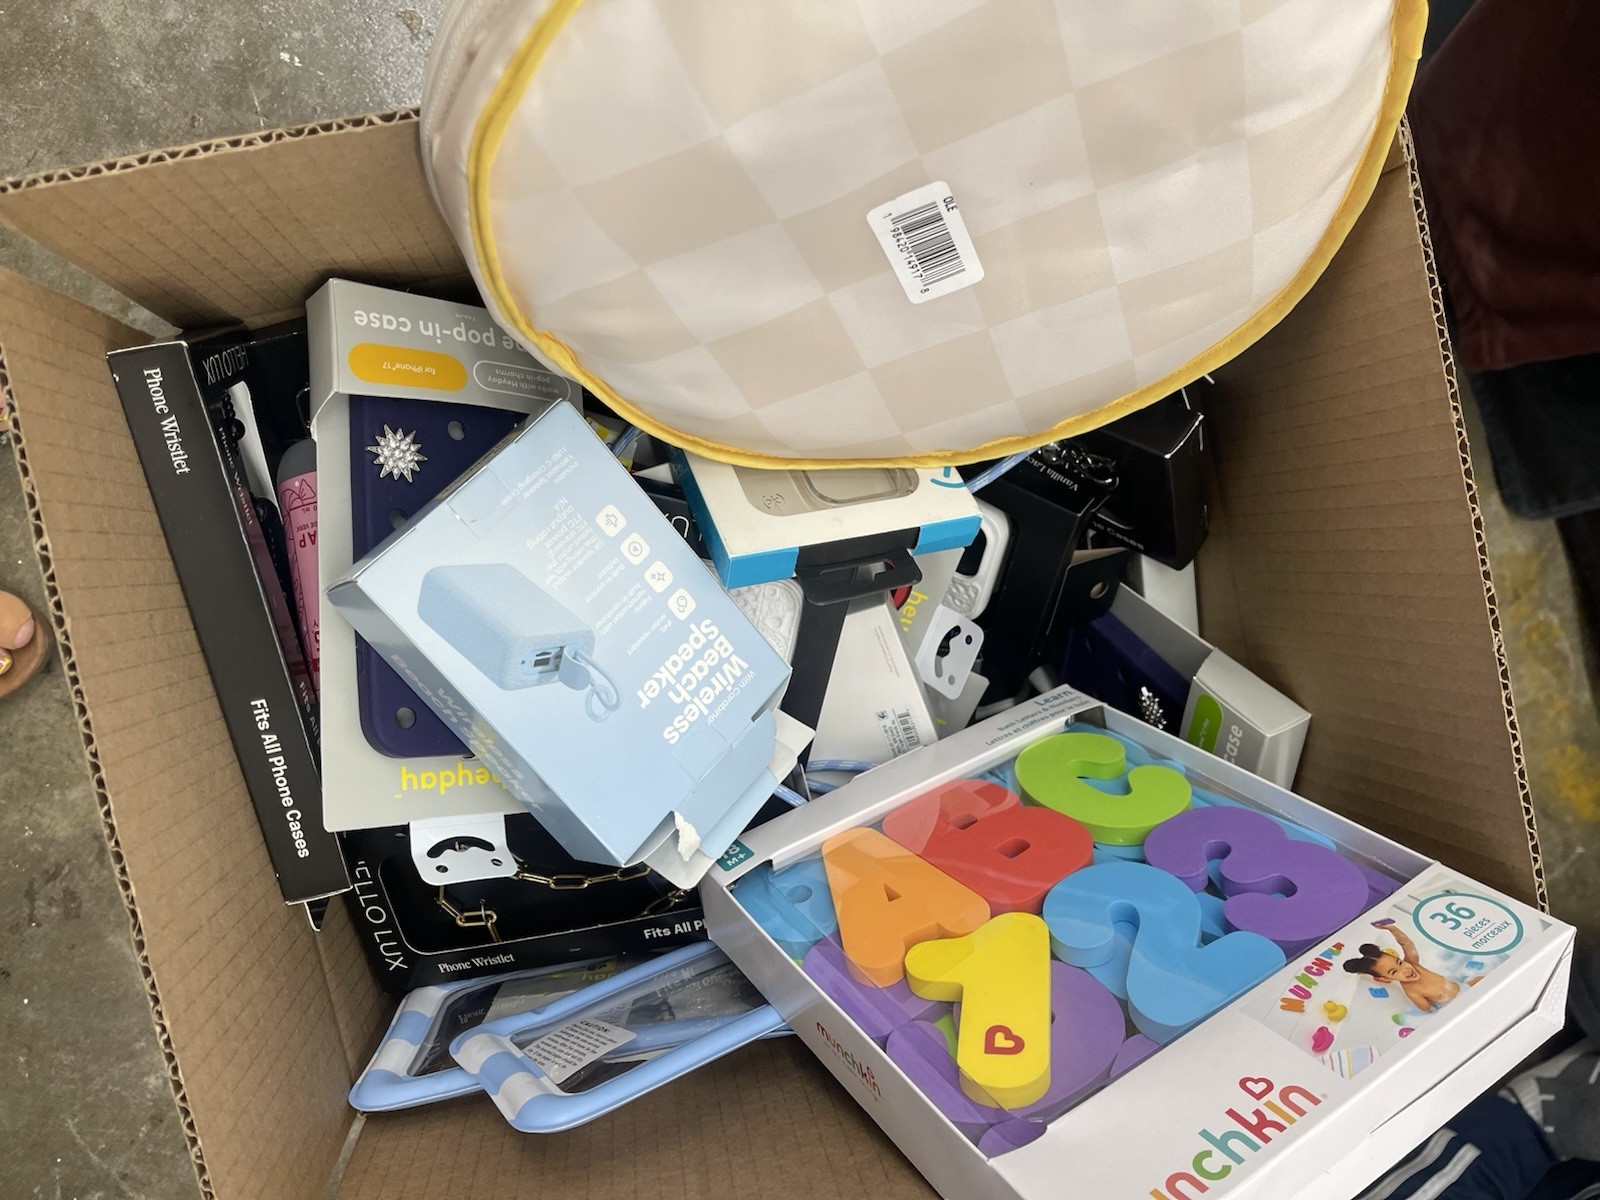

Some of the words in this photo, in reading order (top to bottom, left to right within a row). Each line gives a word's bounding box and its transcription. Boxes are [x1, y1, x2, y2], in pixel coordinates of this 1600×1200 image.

[354, 309, 412, 332] case
[419, 319, 496, 347] pop-in
[202, 354, 225, 386] LUX
[382, 361, 392, 370] 17
[424, 366, 436, 376] for
[495, 369, 524, 379] charms
[526, 374, 550, 383] pop-in
[488, 375, 518, 388] Heyday
[520, 382, 536, 391] with
[143, 368, 169, 414] Phone
[160, 414, 191, 476] Wristlet
[1046, 468, 1078, 491] Vanilla
[550, 505, 574, 529] output
[553, 497, 568, 511] N/A
[567, 512, 583, 528] FTC
[545, 524, 568, 549] power
[636, 619, 719, 709] Speaker
[667, 631, 735, 704] Beach
[738, 670, 756, 688] With
[663, 655, 749, 744] Wireless
[707, 687, 741, 726] Carabiner
[1016, 711, 1042, 723] Letters
[1048, 696, 1082, 709] Numbers
[1034, 690, 1072, 706] Learn
[250, 698, 270, 731] Fits
[986, 732, 1013, 746] Lettres
[1022, 716, 1049, 729] chiffres
[1050, 708, 1066, 717] pour
[261, 734, 282, 754] All
[390, 654, 458, 723] Beach
[460, 726, 544, 812] Speaker
[438, 688, 524, 780] Wireless
[268, 756, 294, 808] Phone
[286, 810, 310, 858] Cases
[726, 853, 746, 866] M+
[354, 861, 386, 924] ELLO
[374, 930, 408, 971] LUX
[1430, 902, 1476, 931] 36
[643, 928, 672, 941] Fits
[674, 922, 692, 934] All
[1472, 920, 1512, 950] morceaux
[438, 958, 472, 974] Phone
[471, 953, 516, 970] Wristlet
[816, 1021, 882, 1098] munchkin
[1149, 1076, 1322, 1200] nchkin
